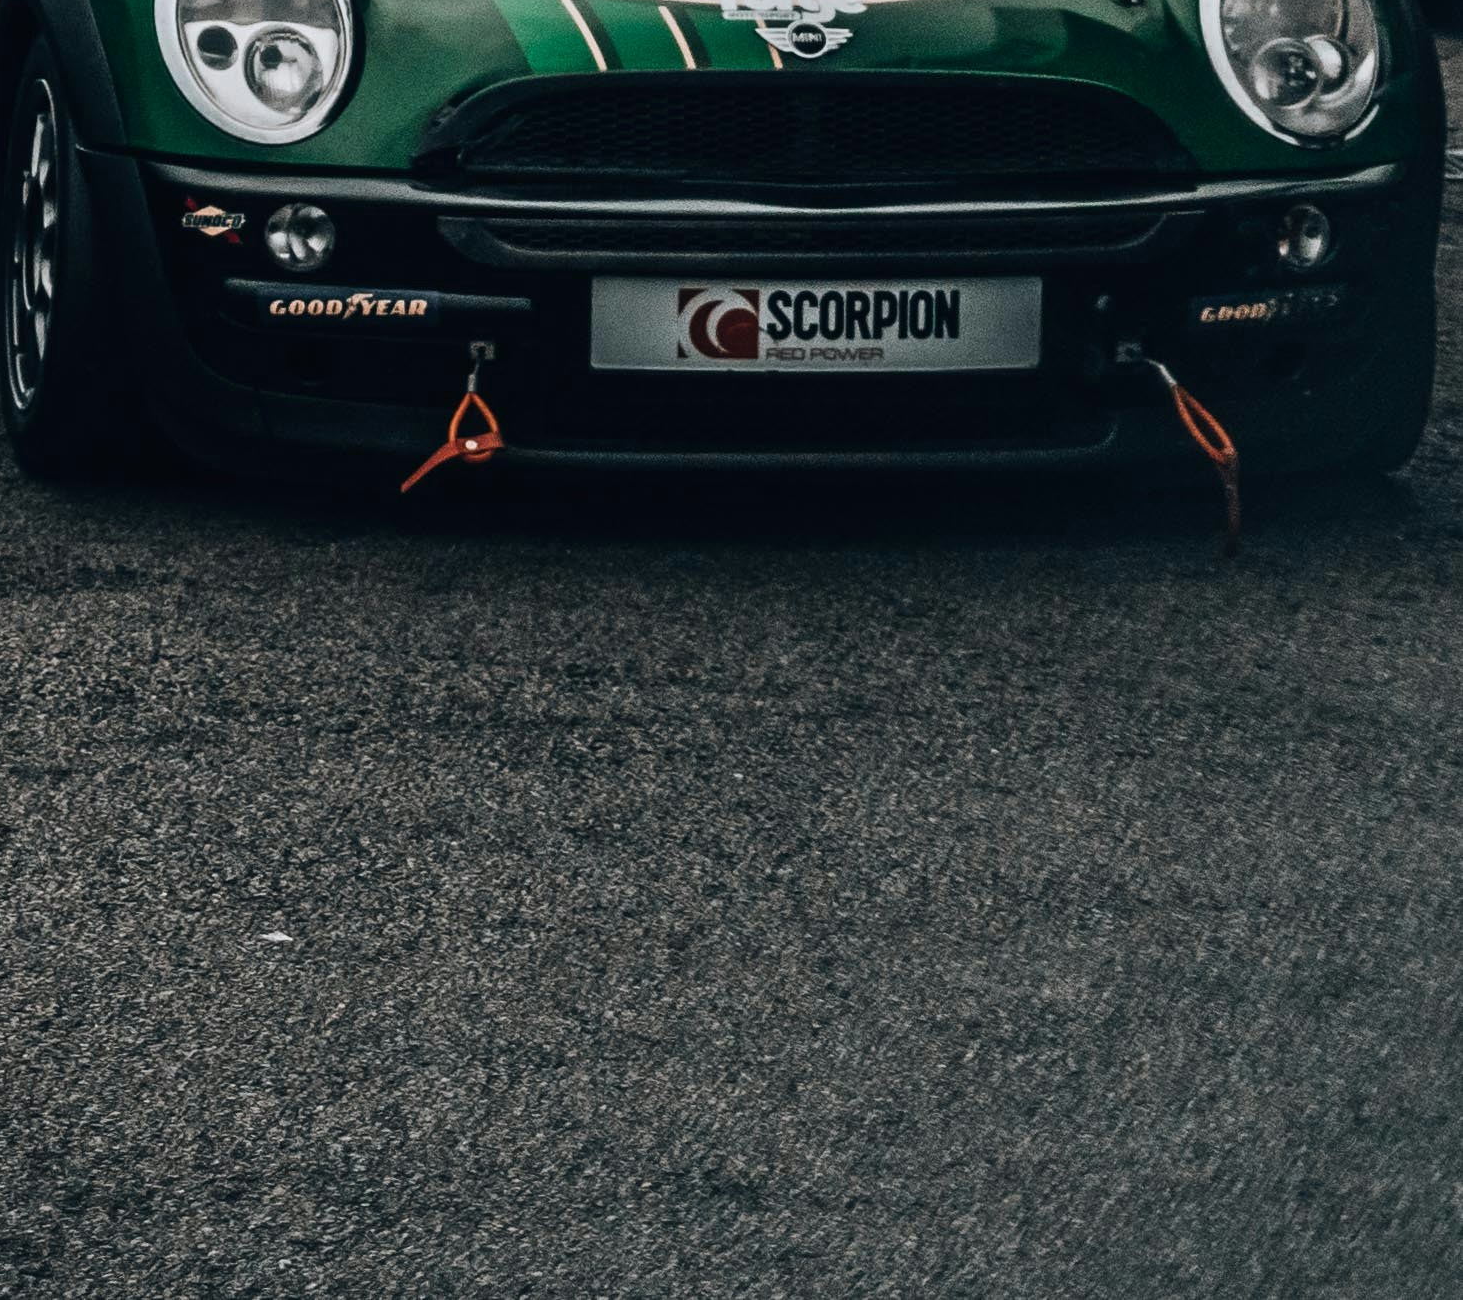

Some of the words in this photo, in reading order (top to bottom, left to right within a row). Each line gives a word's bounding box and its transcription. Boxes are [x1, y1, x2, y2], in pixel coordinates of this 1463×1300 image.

[182, 212, 246, 231] SUNOCO
[269, 292, 428, 320] GOODYEAR
[766, 289, 960, 341] SCORPION
[766, 347, 806, 361] RED
[812, 347, 884, 361] POWER
